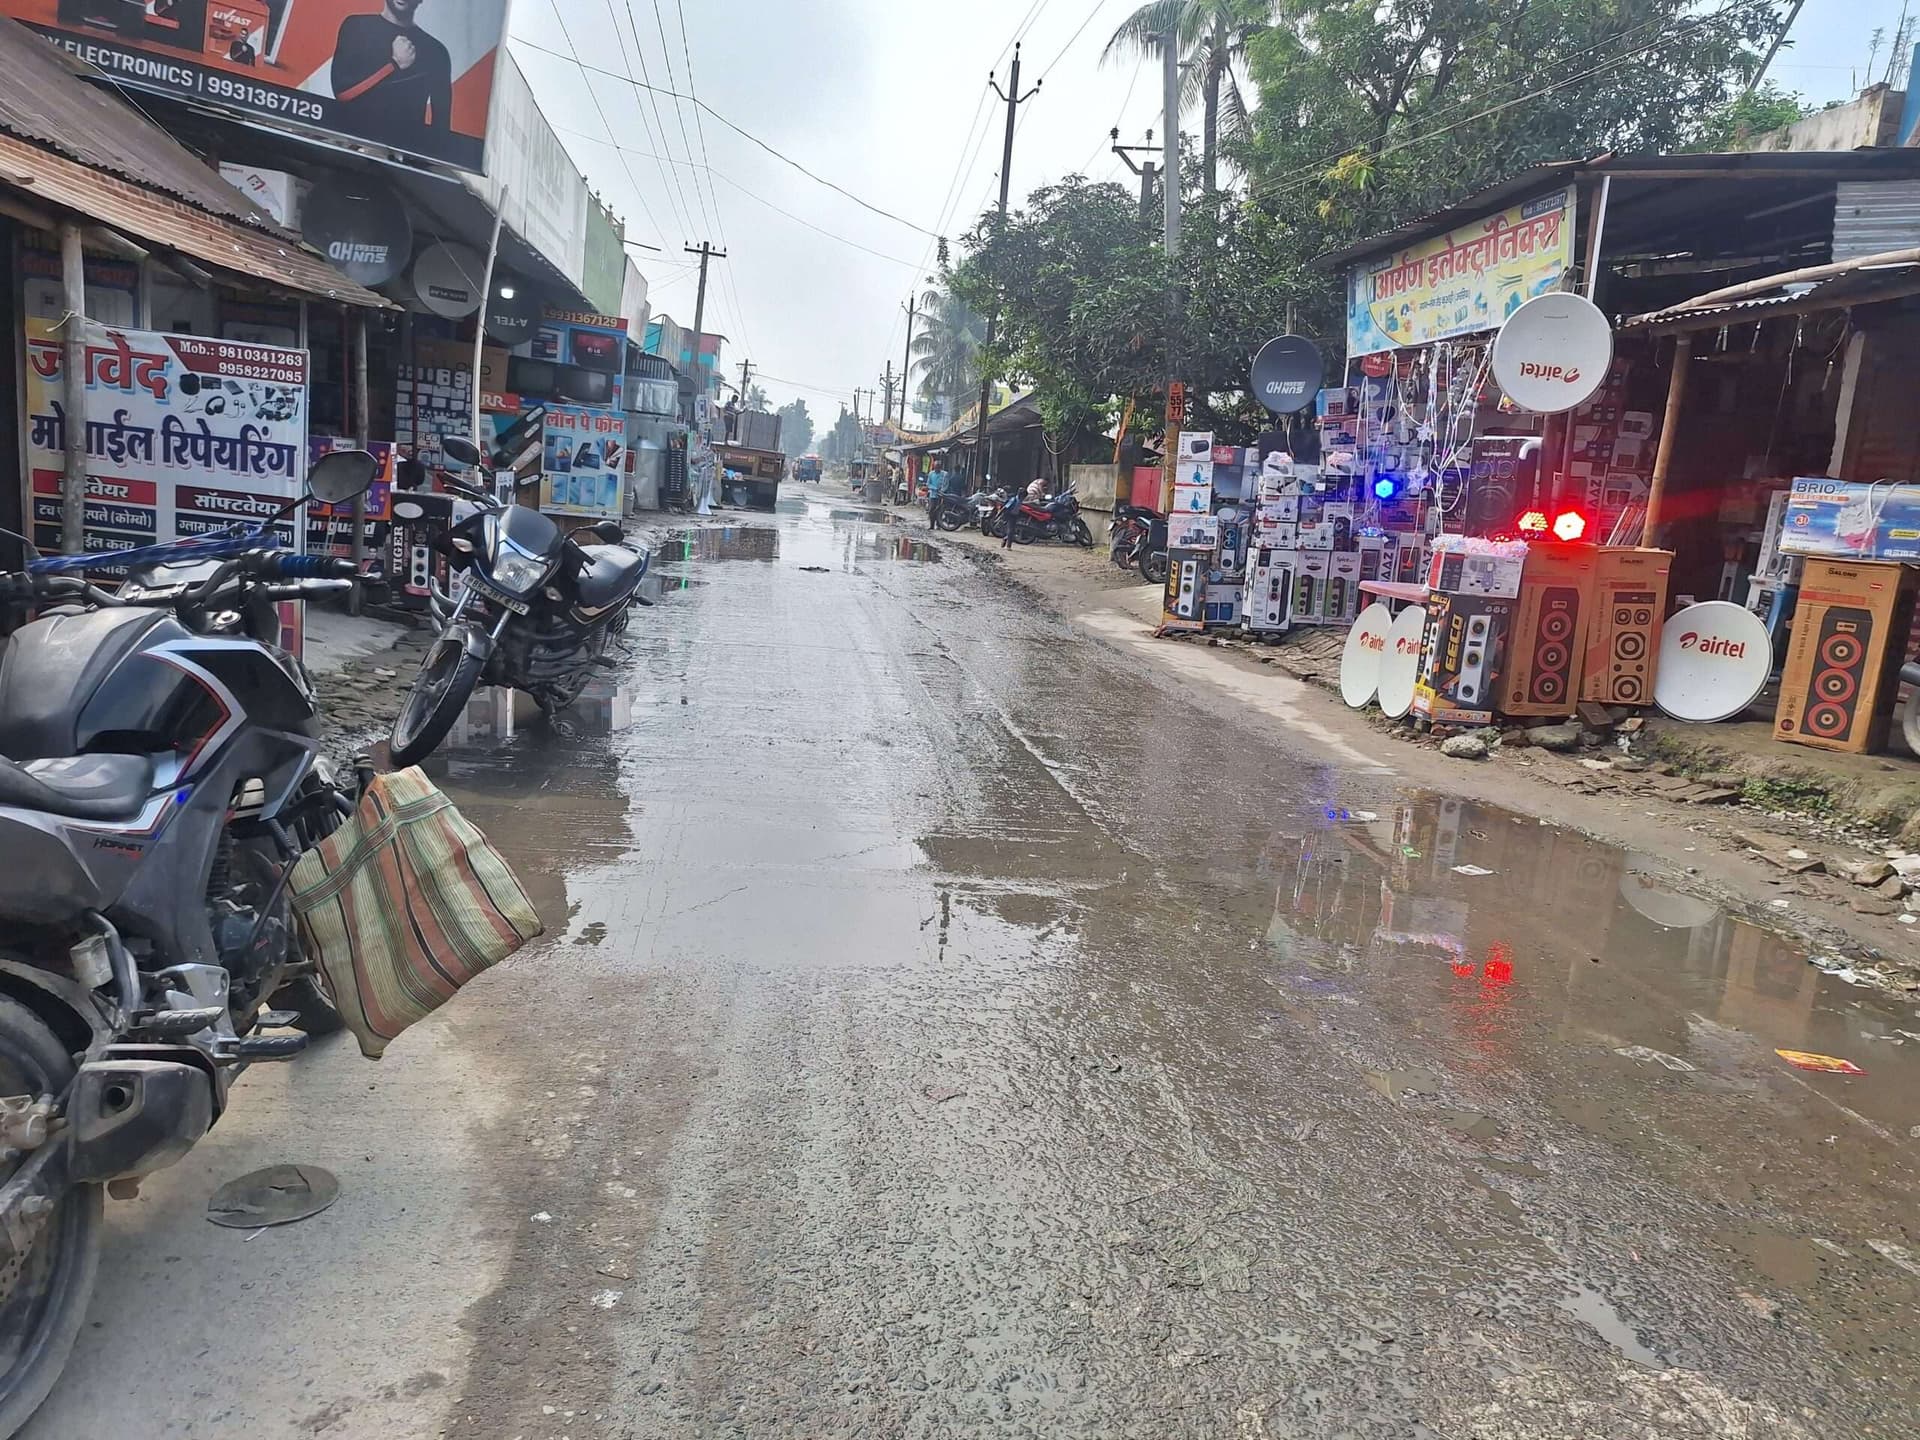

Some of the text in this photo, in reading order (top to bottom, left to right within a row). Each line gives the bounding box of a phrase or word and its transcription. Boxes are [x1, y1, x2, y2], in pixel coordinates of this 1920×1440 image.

[64, 40, 194, 86] ELECTRONICS
[207, 76, 323, 121] 9931367129
[494, 314, 528, 328] A-TEL
[180, 340, 303, 367] Mob.: 9810341263
[218, 362, 303, 383] 9958227085
[1520, 362, 1564, 381] airtel
[546, 409, 624, 434] लोन पे फोन
[161, 414, 298, 478] रिपेयरिंग
[1796, 482, 1836, 494] BRIO
[393, 525, 404, 574] TIGER
[1699, 636, 1745, 659] airtel
